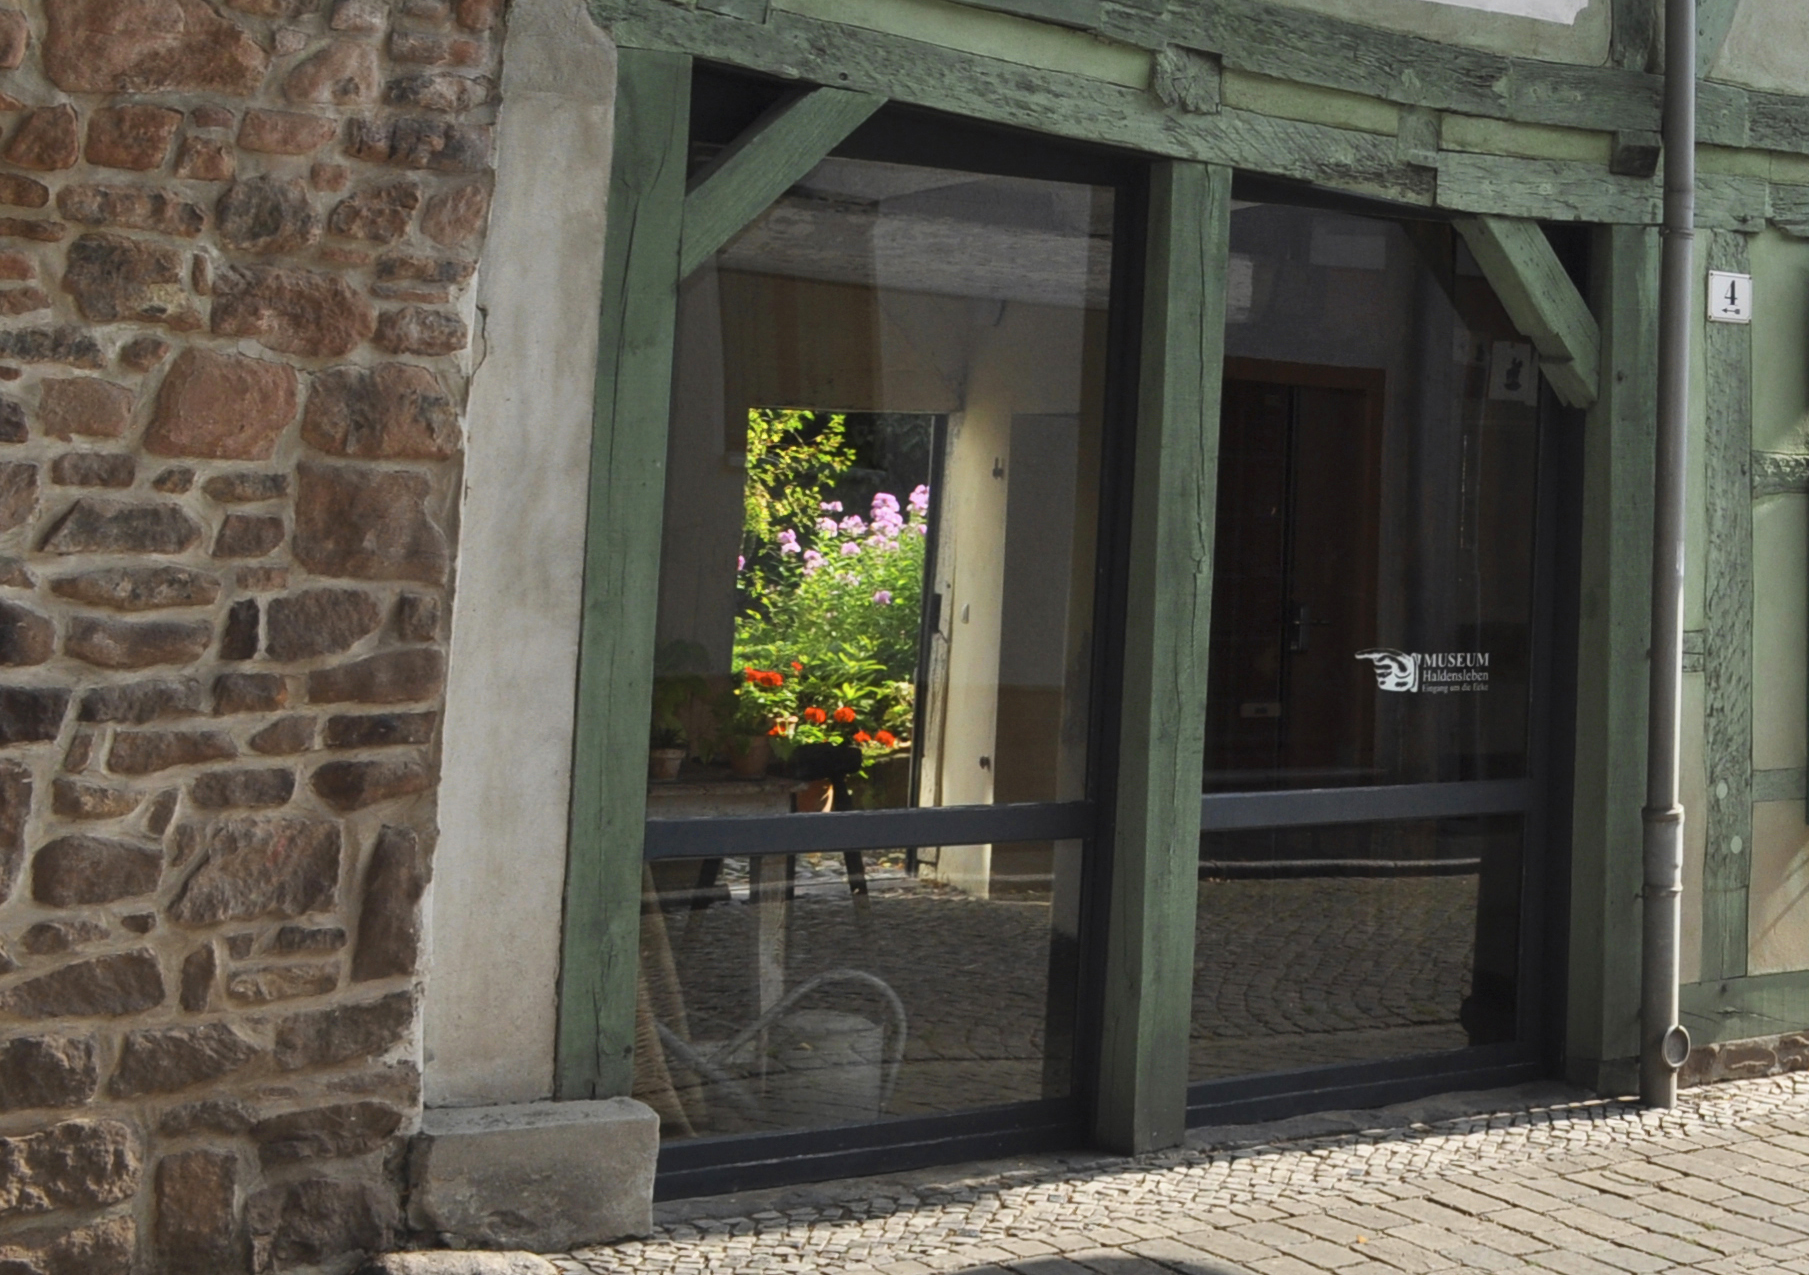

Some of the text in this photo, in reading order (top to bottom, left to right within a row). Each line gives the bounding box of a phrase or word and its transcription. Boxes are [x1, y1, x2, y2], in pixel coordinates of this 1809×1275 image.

[1724, 279, 1738, 306] 4
[1423, 652, 1489, 668] MUSEUM
[1422, 668, 1489, 682] Haldensleben
